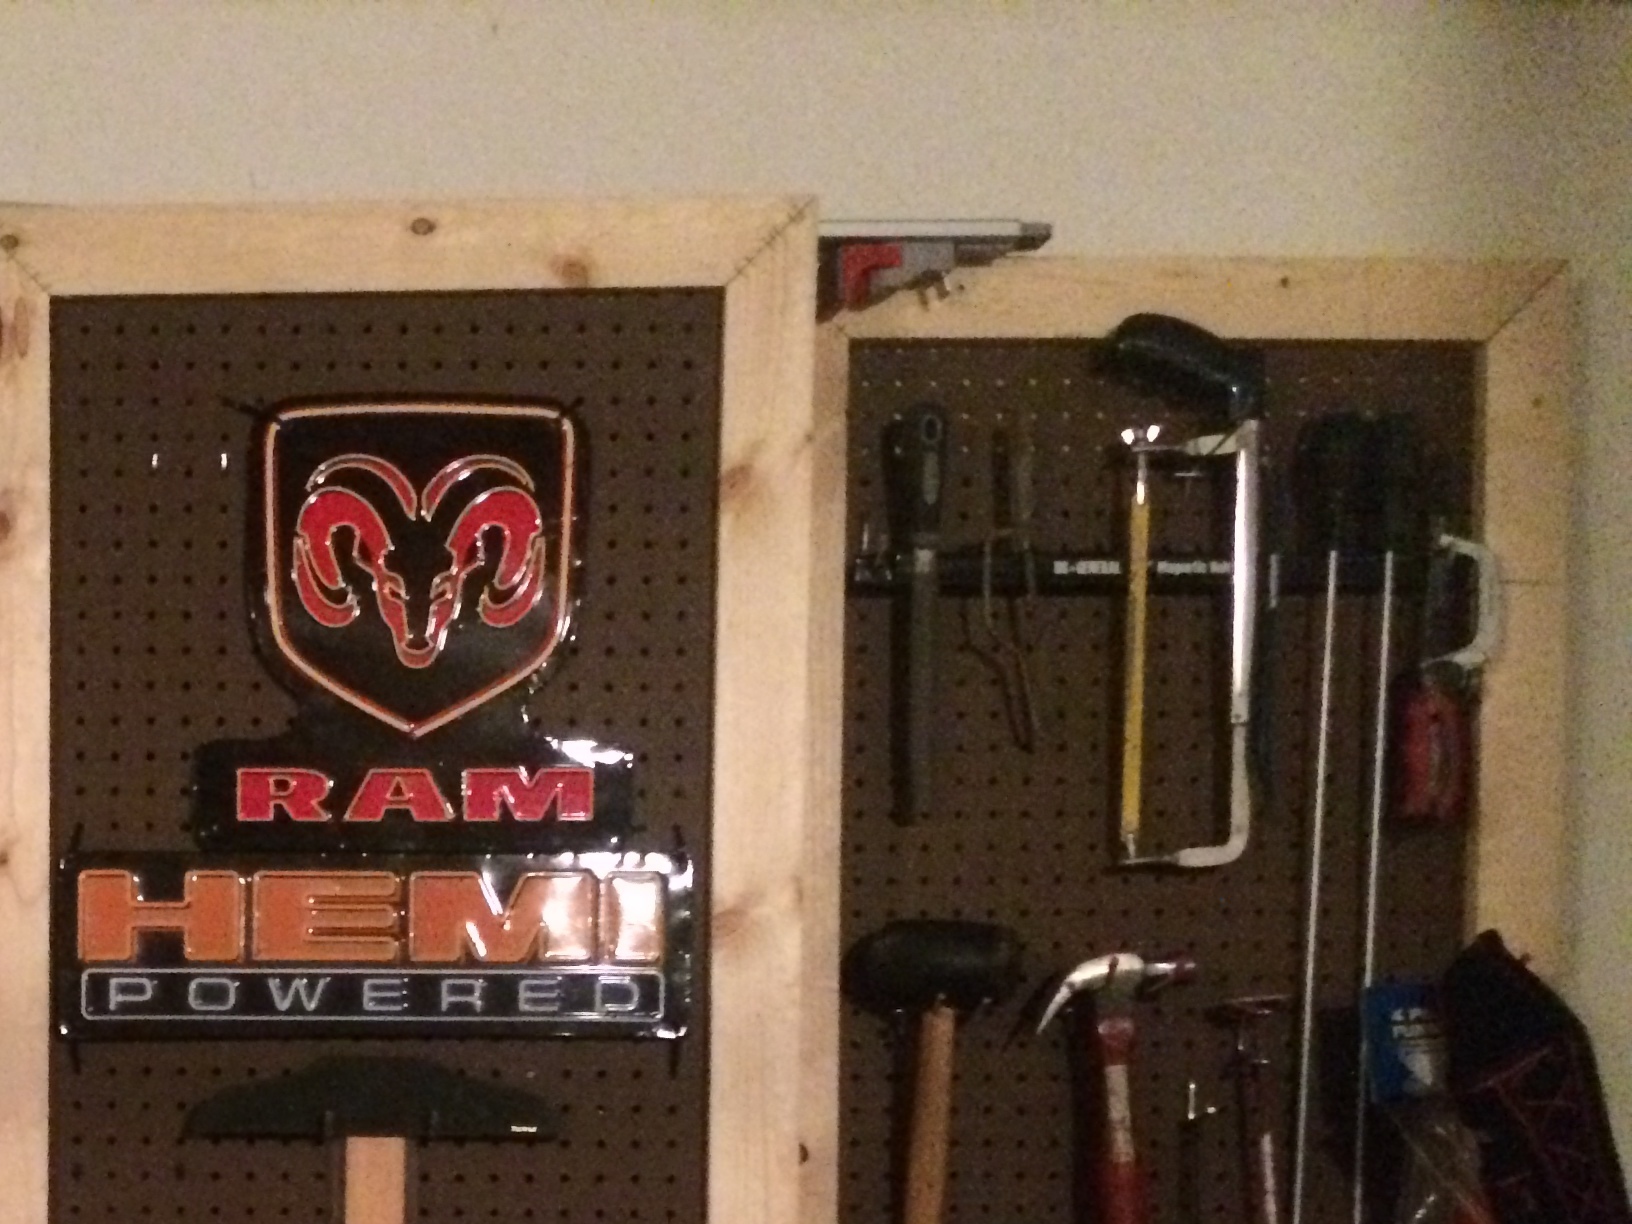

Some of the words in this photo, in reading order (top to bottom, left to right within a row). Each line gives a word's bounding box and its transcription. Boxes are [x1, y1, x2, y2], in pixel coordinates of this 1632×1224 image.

[236, 767, 596, 822] RAM
[77, 869, 667, 963] HEMI
[107, 976, 640, 1013] POWERED
